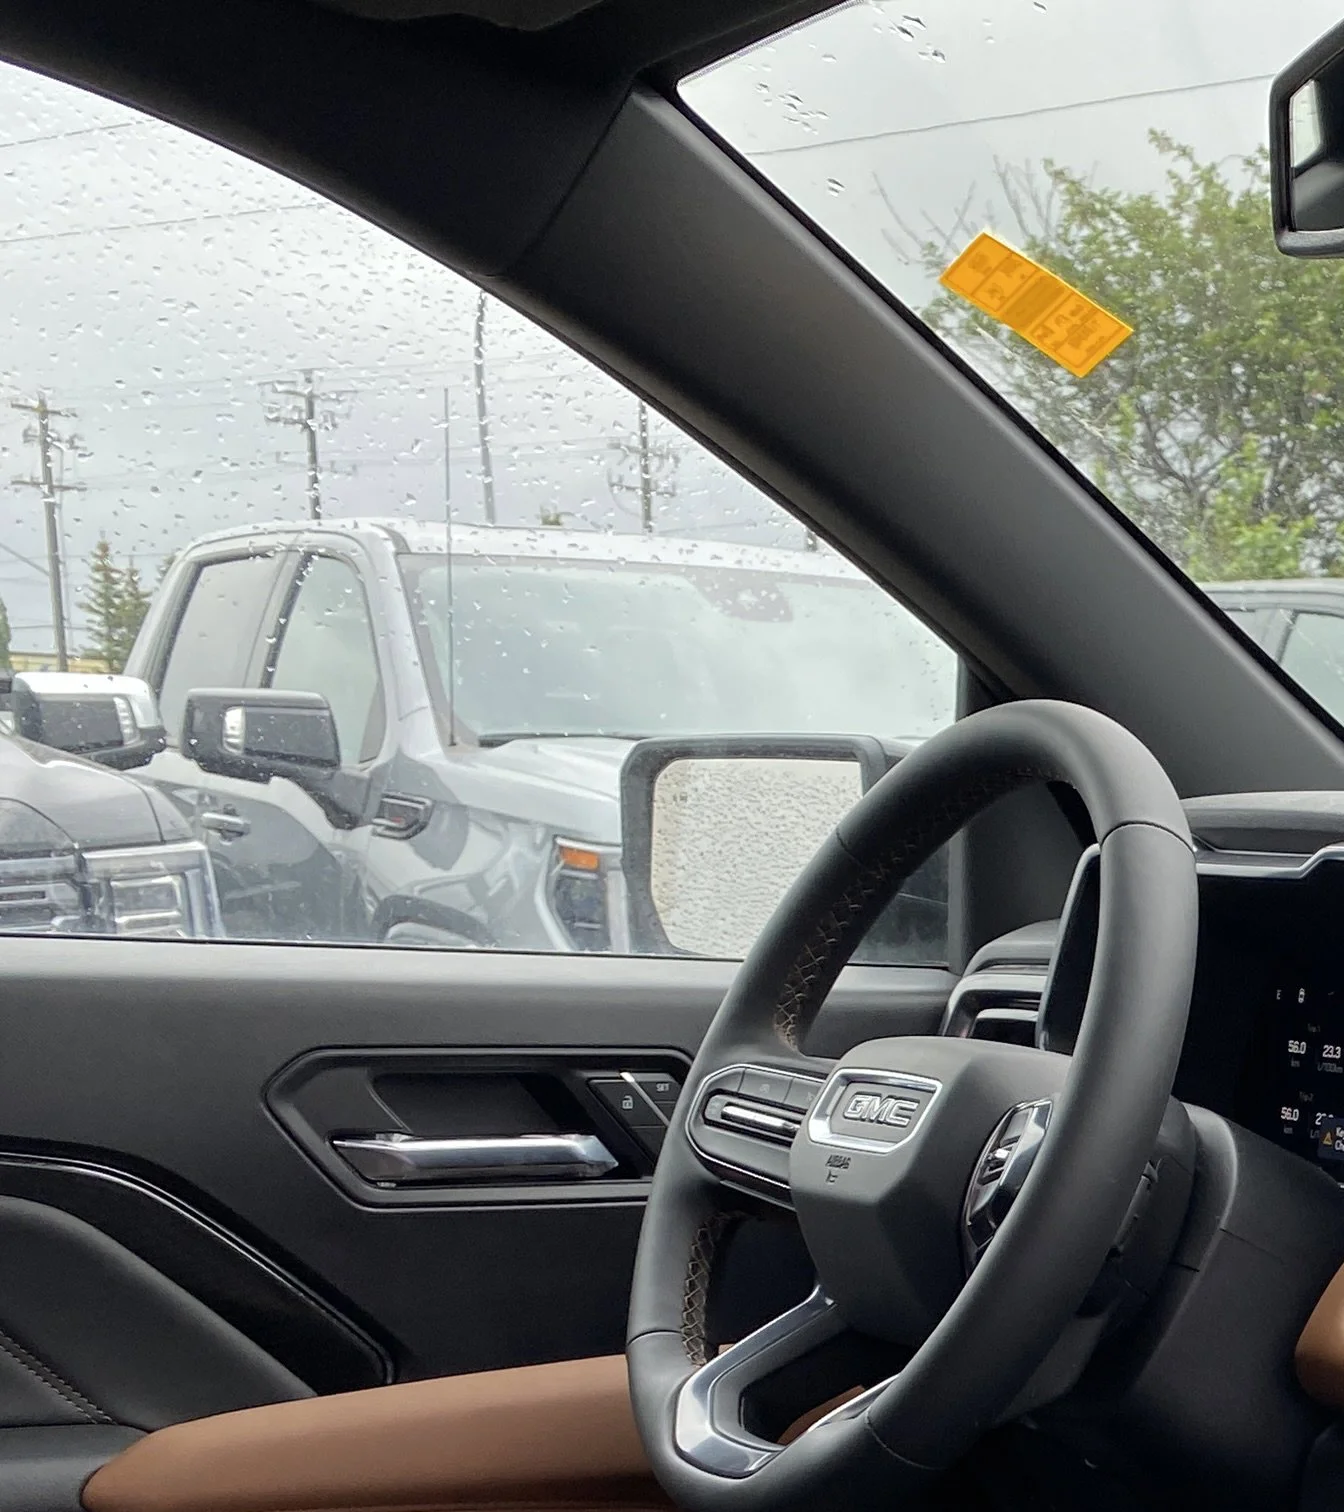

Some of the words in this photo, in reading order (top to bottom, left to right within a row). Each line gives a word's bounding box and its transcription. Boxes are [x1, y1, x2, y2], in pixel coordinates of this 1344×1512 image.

[1288, 1040, 1306, 1055] 56.0
[1322, 1044, 1341, 1059] 23.3
[843, 1091, 920, 1128] GMC
[1280, 1106, 1300, 1122] 56.0
